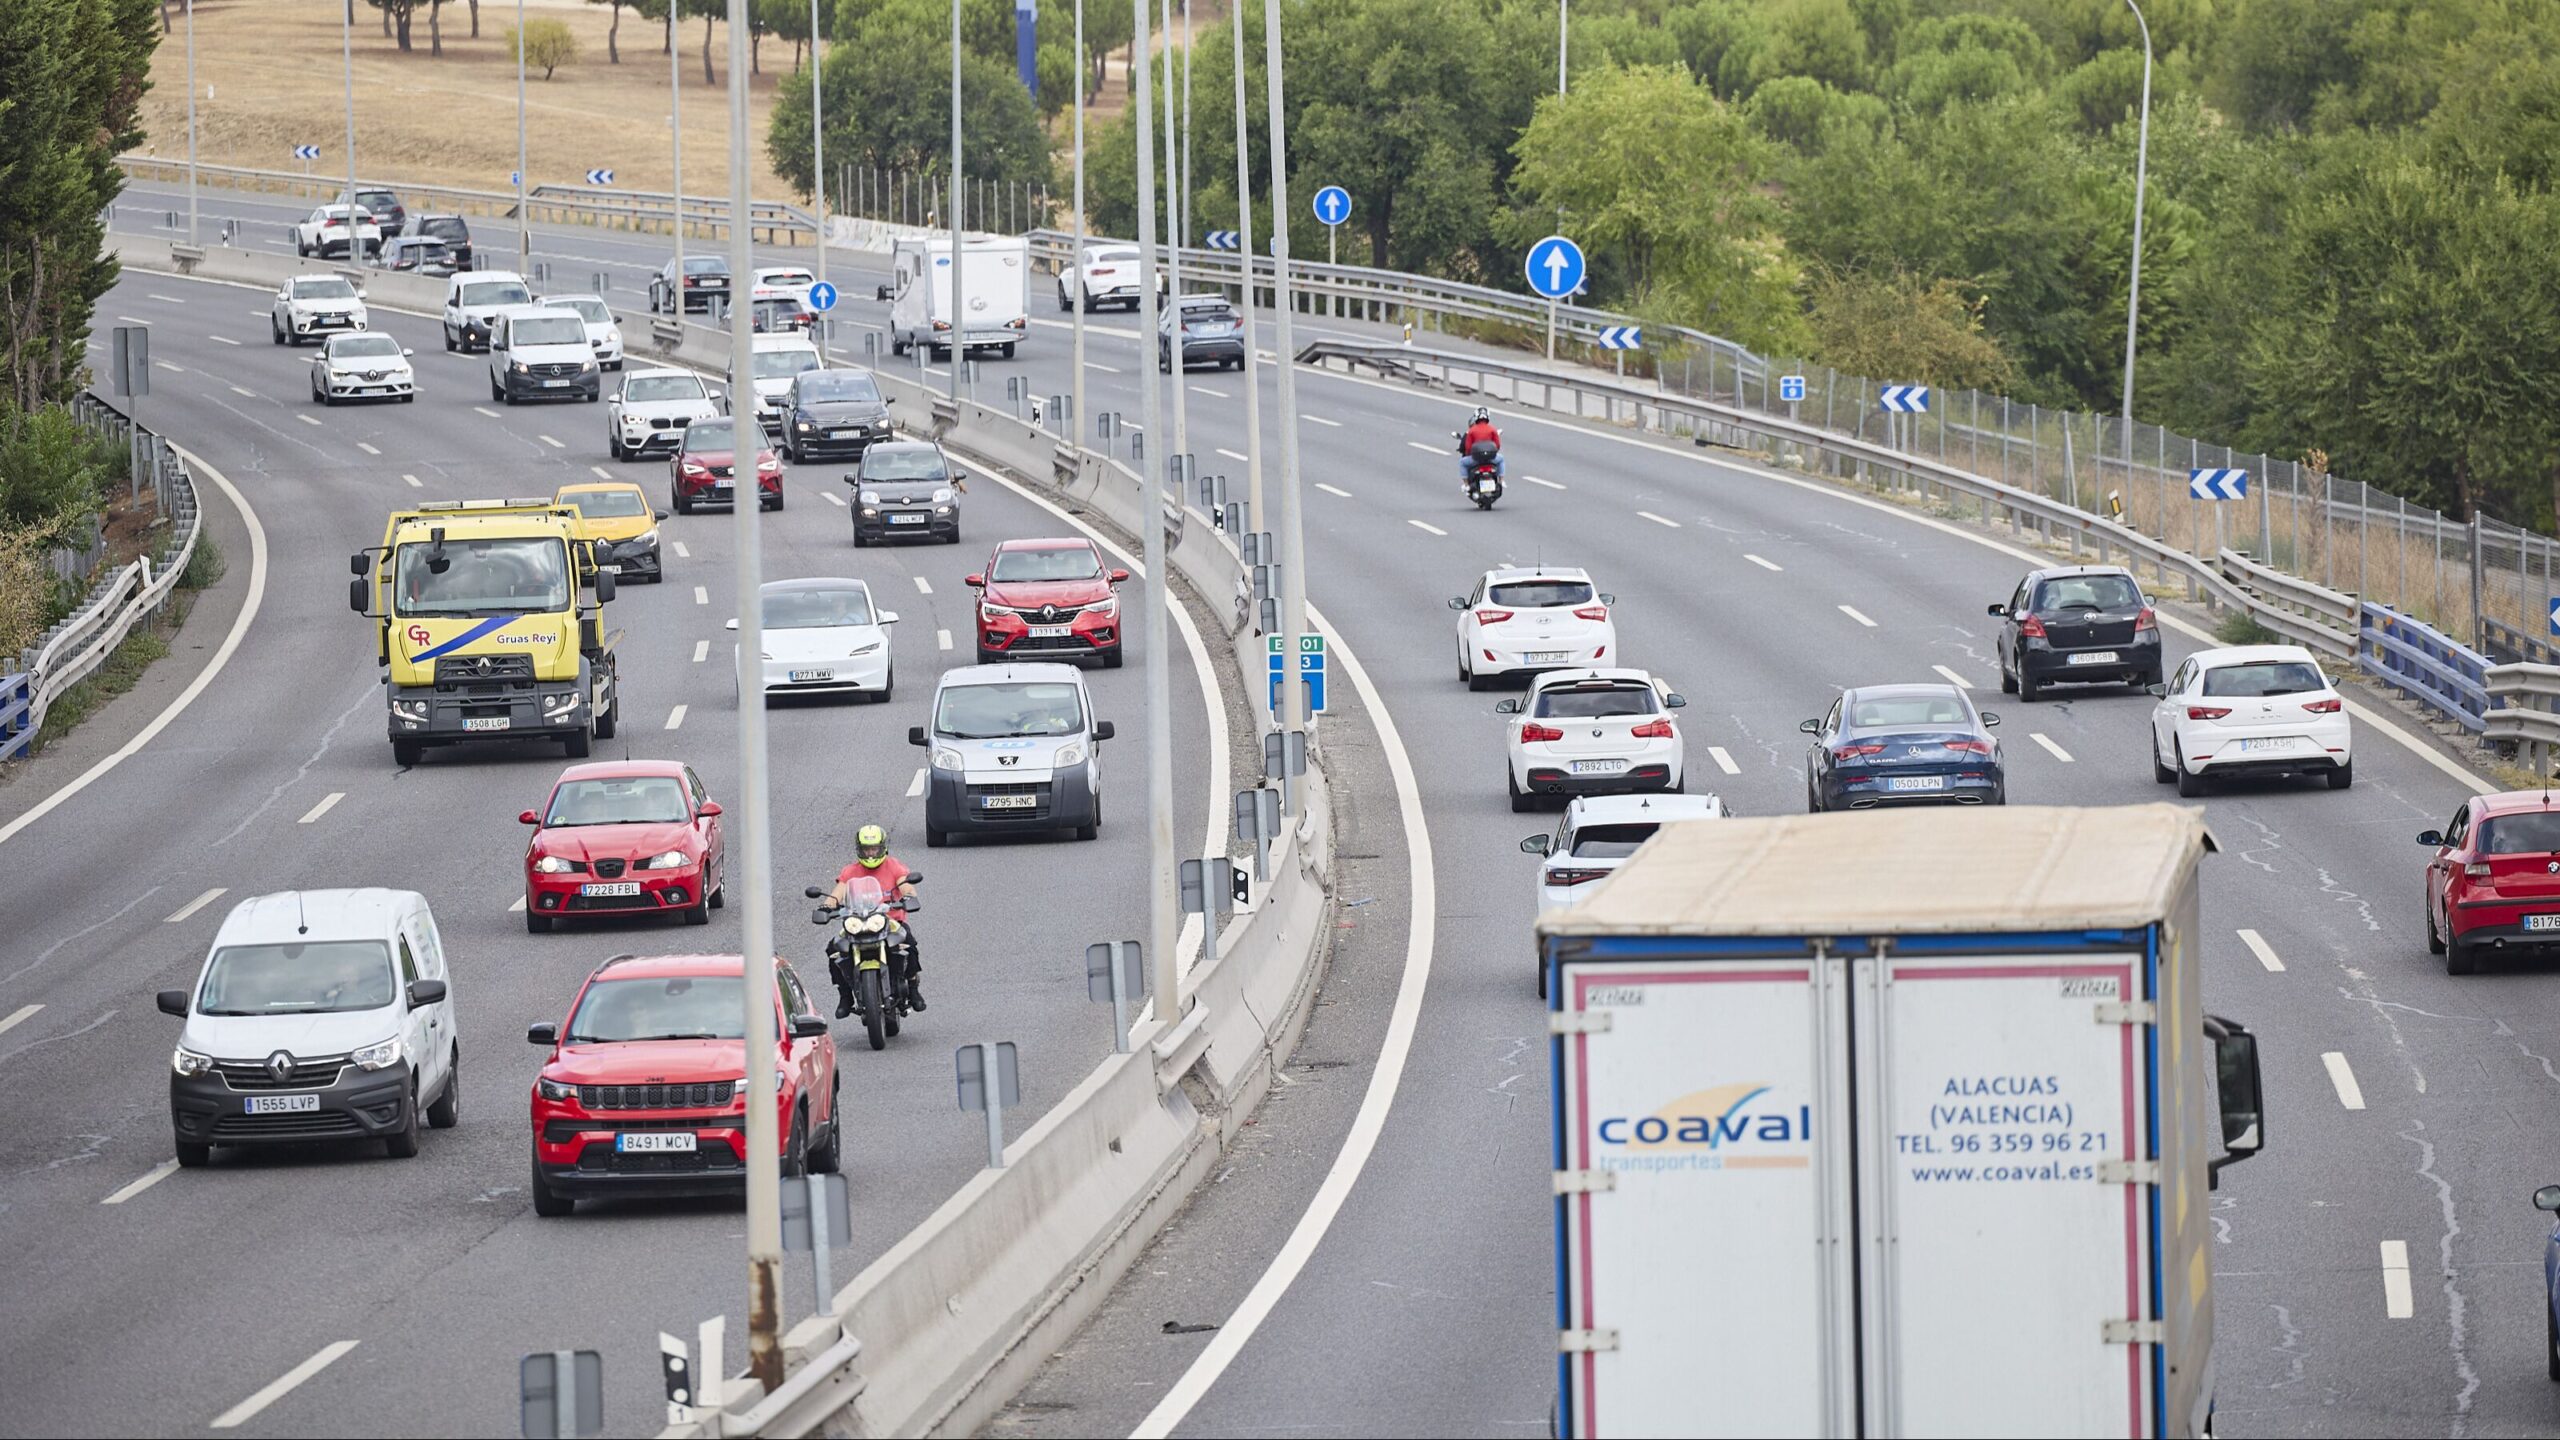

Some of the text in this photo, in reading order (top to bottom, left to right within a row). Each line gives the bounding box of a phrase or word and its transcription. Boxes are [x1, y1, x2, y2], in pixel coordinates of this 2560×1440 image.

[1035, 627, 1069, 636] 1331 MLY
[496, 632, 556, 645] Gruas Reyi
[1530, 653, 1549, 661] 9712
[795, 669, 832, 679] 8771 MMV
[469, 718, 508, 728] 3508 LGH
[2248, 739, 2271, 749] 7203
[1579, 761, 1622, 771] 2892 LTG
[1895, 777, 1940, 788] 0500 LPN
[989, 796, 1033, 807] 2795 HNC
[587, 884, 637, 896] 7228 FBL
[2532, 916, 2560, 928] 8176
[1944, 1076, 2059, 1096] ALACUAS
[256, 1097, 315, 1111] 1555 LVP
[1931, 1102, 2073, 1130] (VALENCIA)
[1598, 1105, 1810, 1145] coaval
[626, 1135, 692, 1149] 8491 MCV
[1896, 1132, 2107, 1153] TEL. 96 359 96 21
[1600, 1154, 1722, 1172] transportes
[1911, 1161, 2093, 1181] www.coaval.es
